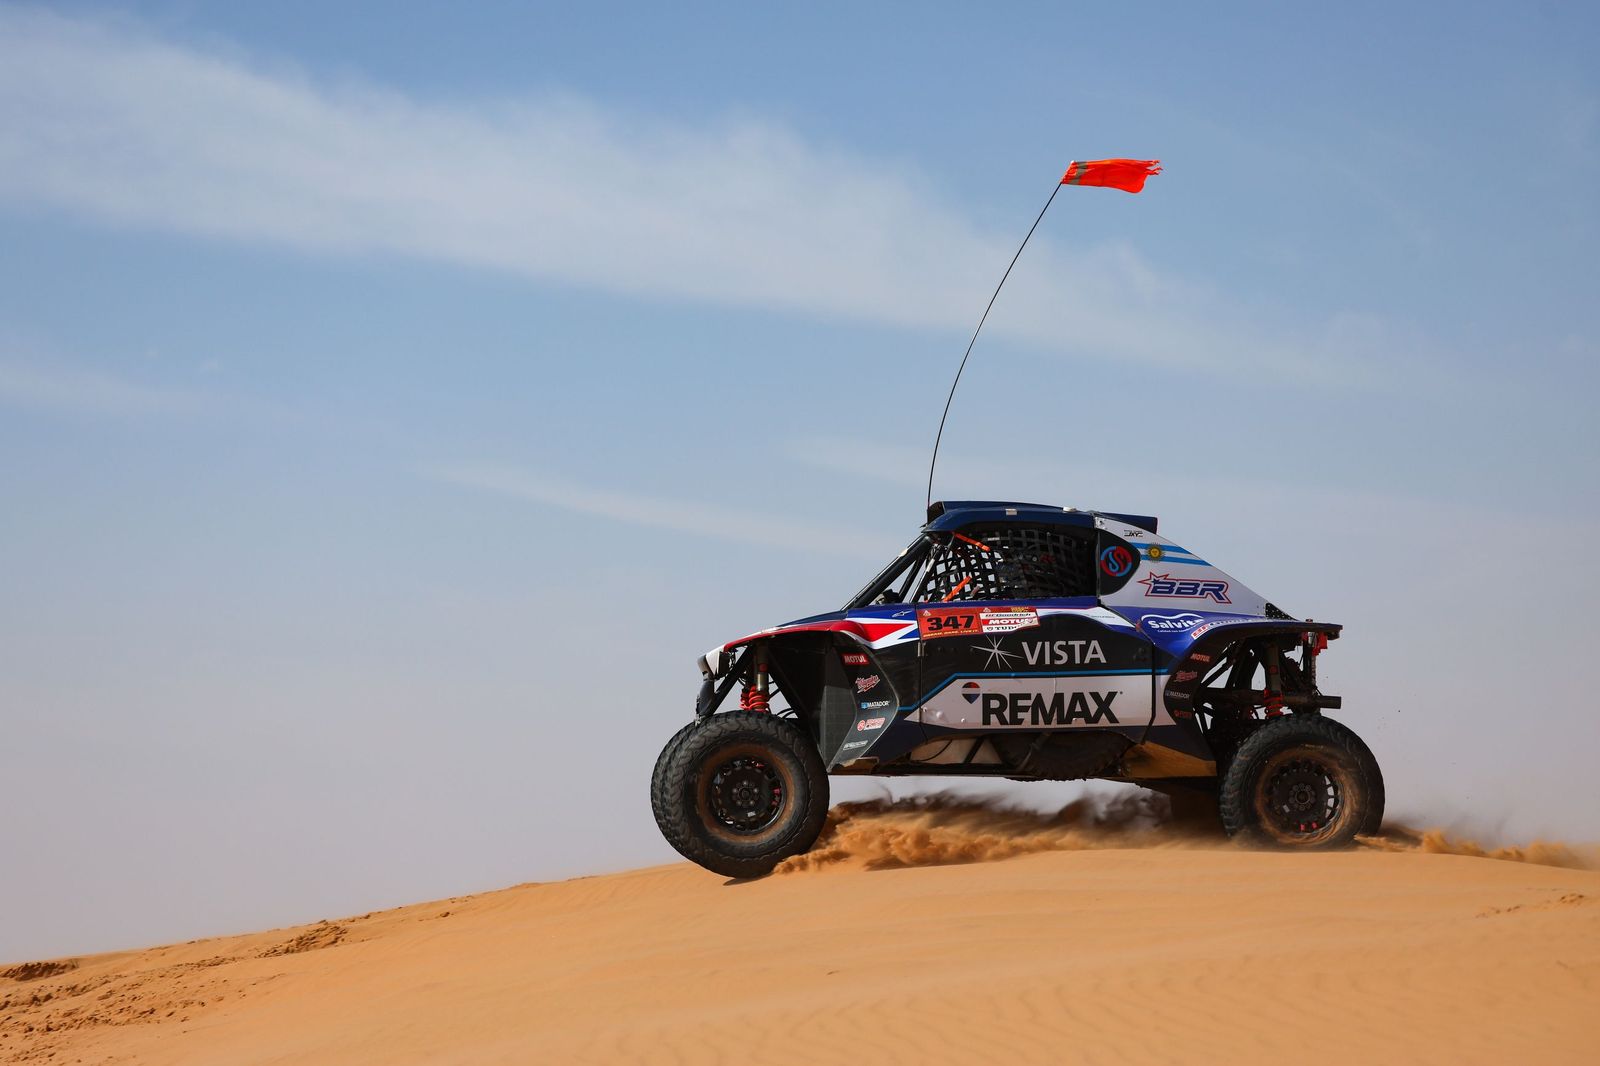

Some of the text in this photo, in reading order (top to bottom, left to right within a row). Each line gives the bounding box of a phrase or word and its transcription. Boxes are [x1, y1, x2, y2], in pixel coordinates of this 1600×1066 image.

[1150, 580, 1226, 601] BBR
[926, 615, 974, 631] 347
[1022, 640, 1107, 665] VISTA
[982, 691, 1120, 726] REMAX
